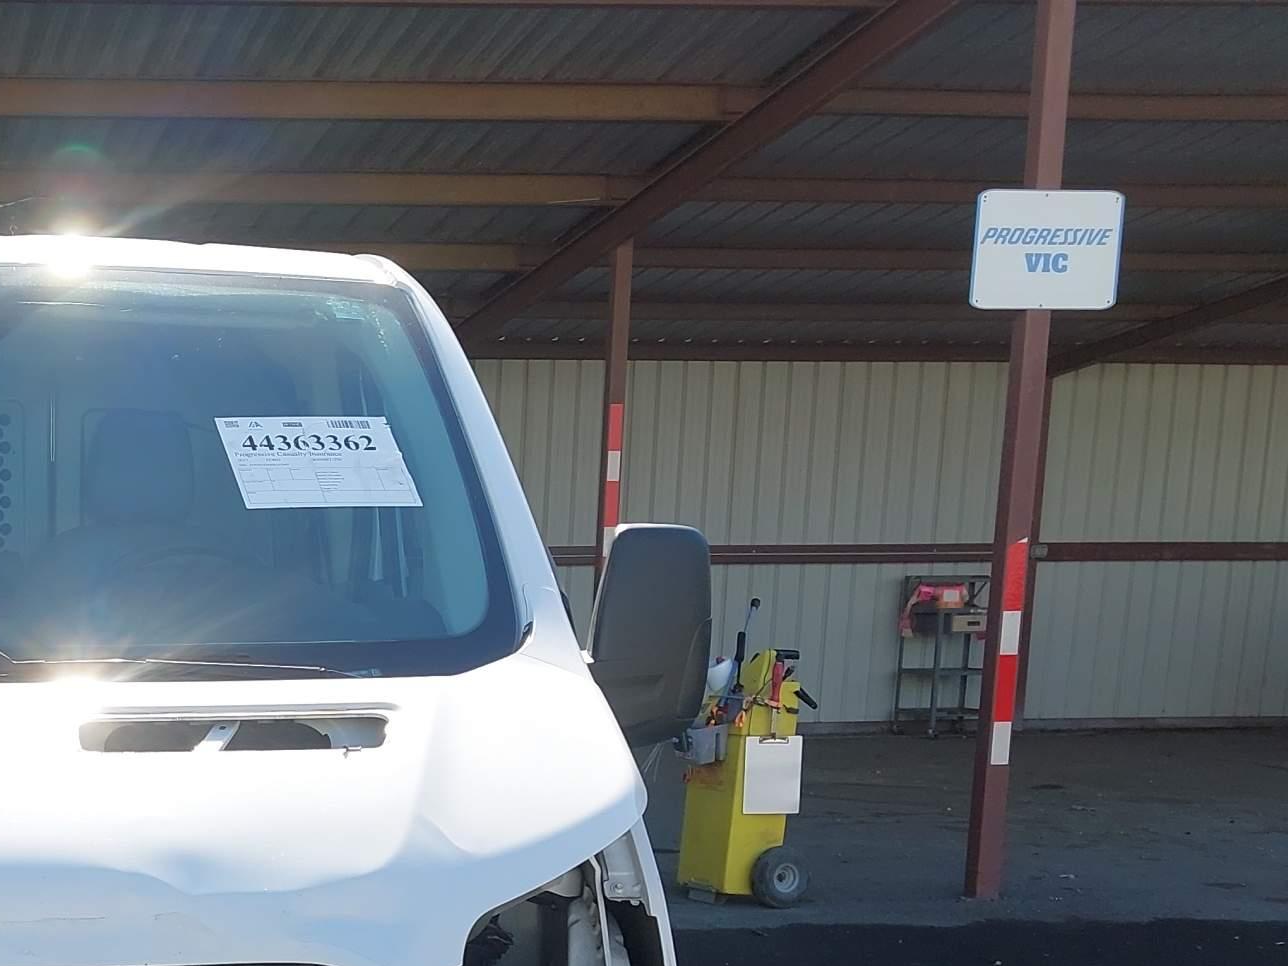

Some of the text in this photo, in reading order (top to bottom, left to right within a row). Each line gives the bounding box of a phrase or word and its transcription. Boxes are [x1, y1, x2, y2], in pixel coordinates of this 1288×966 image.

[980, 227, 1113, 246] PROGRESSIVE
[1024, 252, 1069, 273] VIC
[242, 434, 377, 452] 44363362
